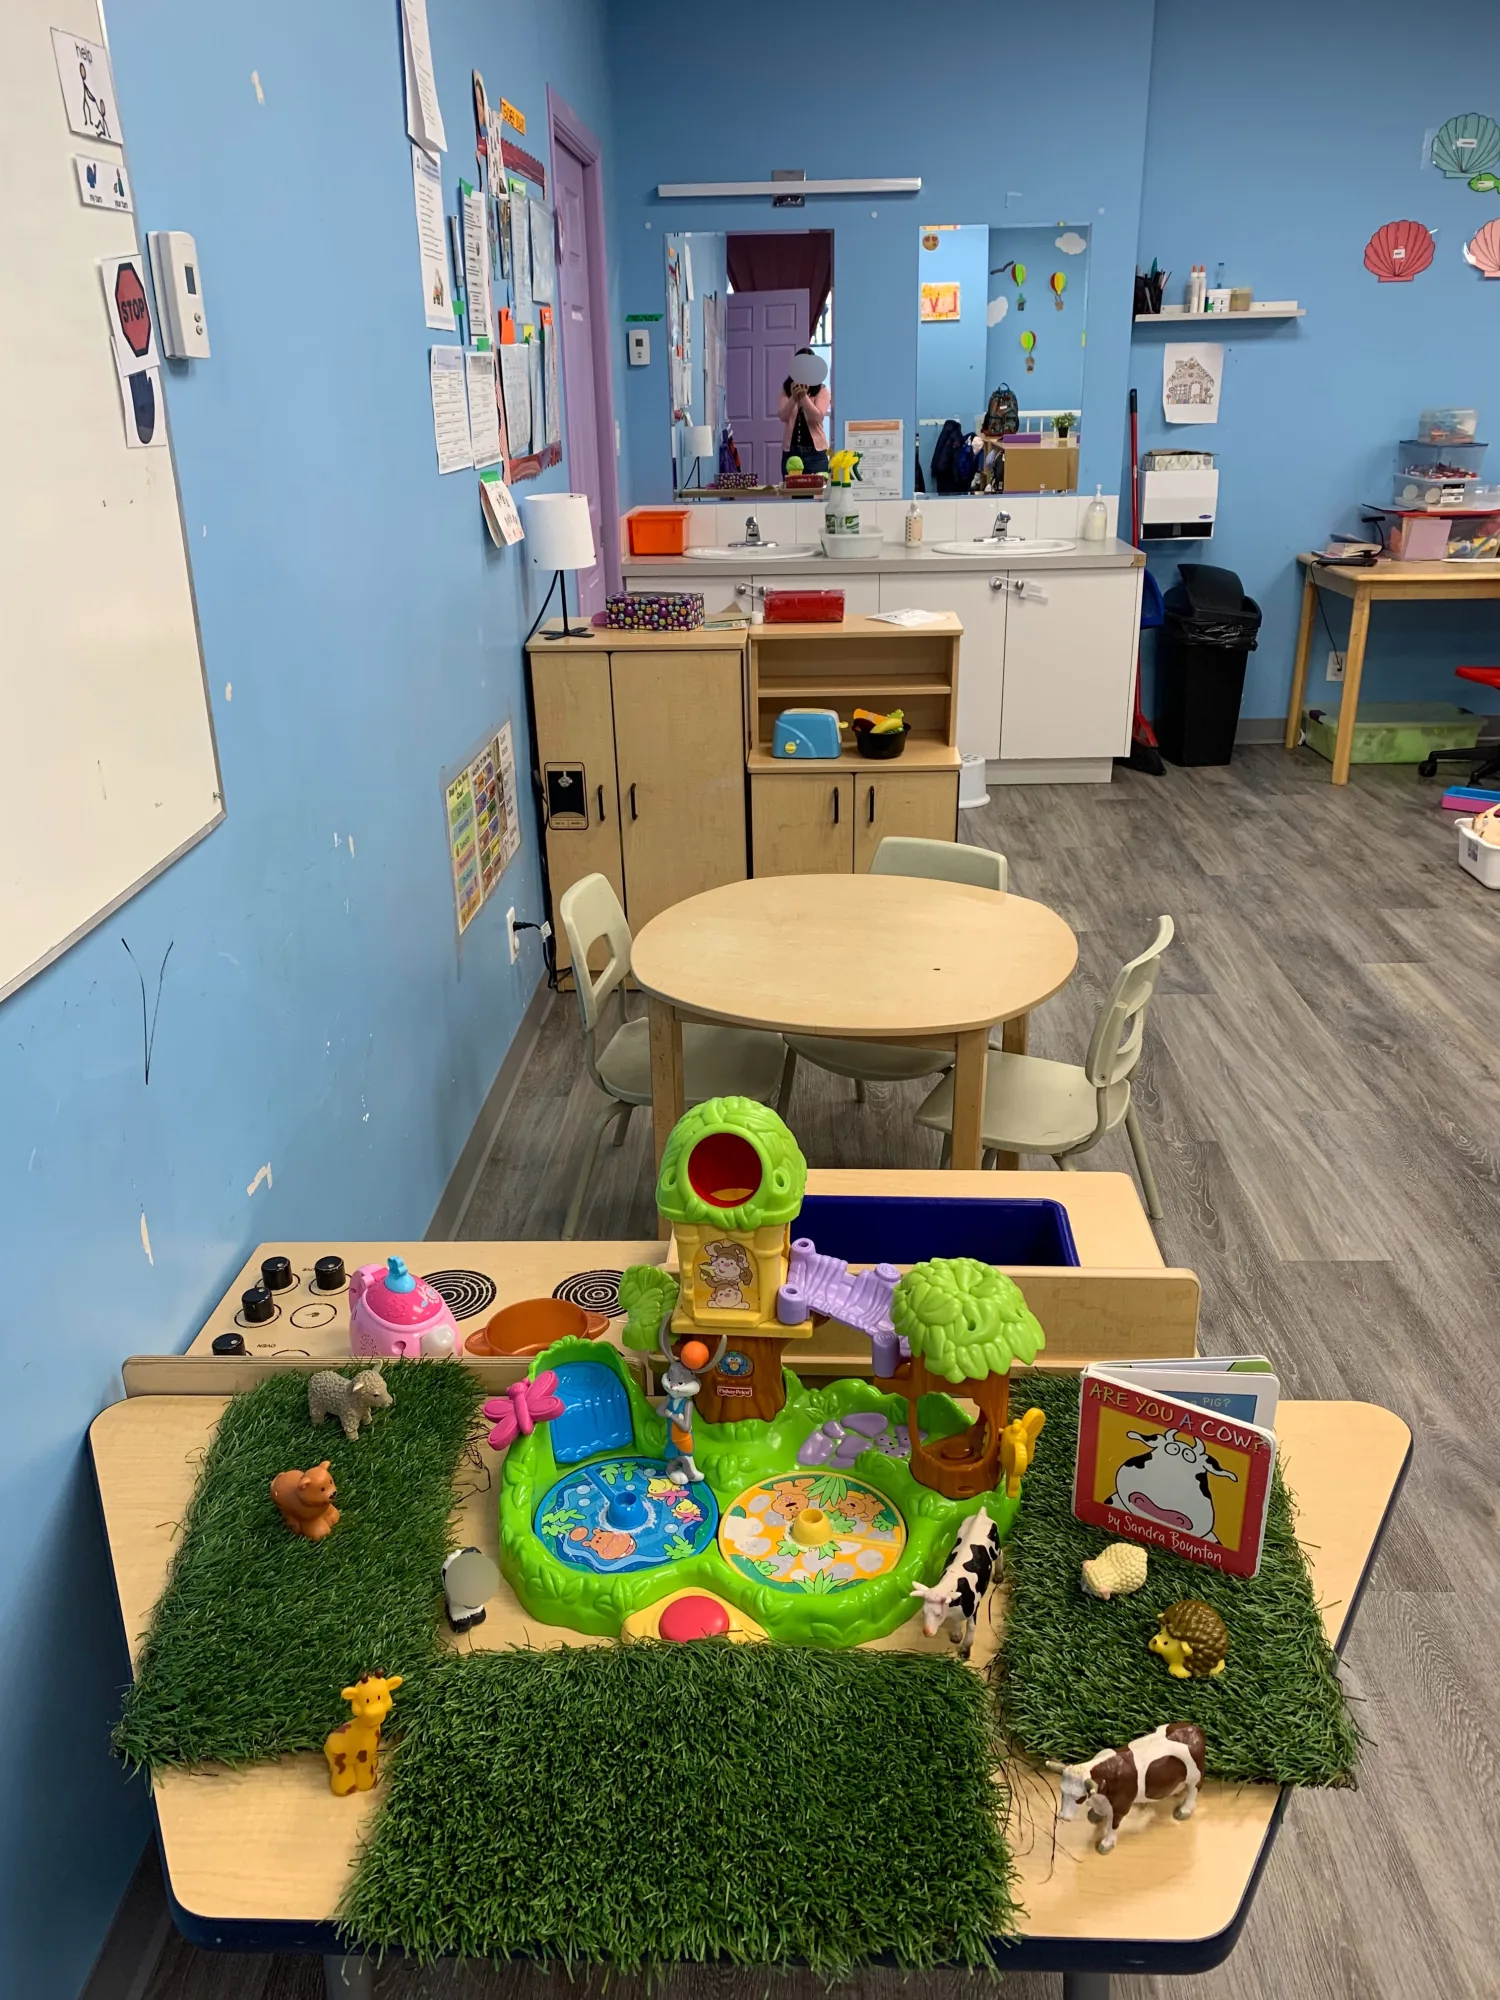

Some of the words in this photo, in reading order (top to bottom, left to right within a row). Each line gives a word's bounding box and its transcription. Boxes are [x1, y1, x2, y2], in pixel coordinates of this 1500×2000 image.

[74, 41, 93, 65] help
[121, 298, 145, 323] STOP
[1203, 1397, 1231, 1409] PIG?
[1089, 1383, 1129, 1408] ARE
[1135, 1397, 1175, 1422] YOU
[1179, 1413, 1193, 1431] A
[1200, 1420, 1265, 1454] COW?
[1107, 1511, 1121, 1530] by
[1123, 1515, 1166, 1544] Sandra
[1169, 1531, 1222, 1563] Boynton
